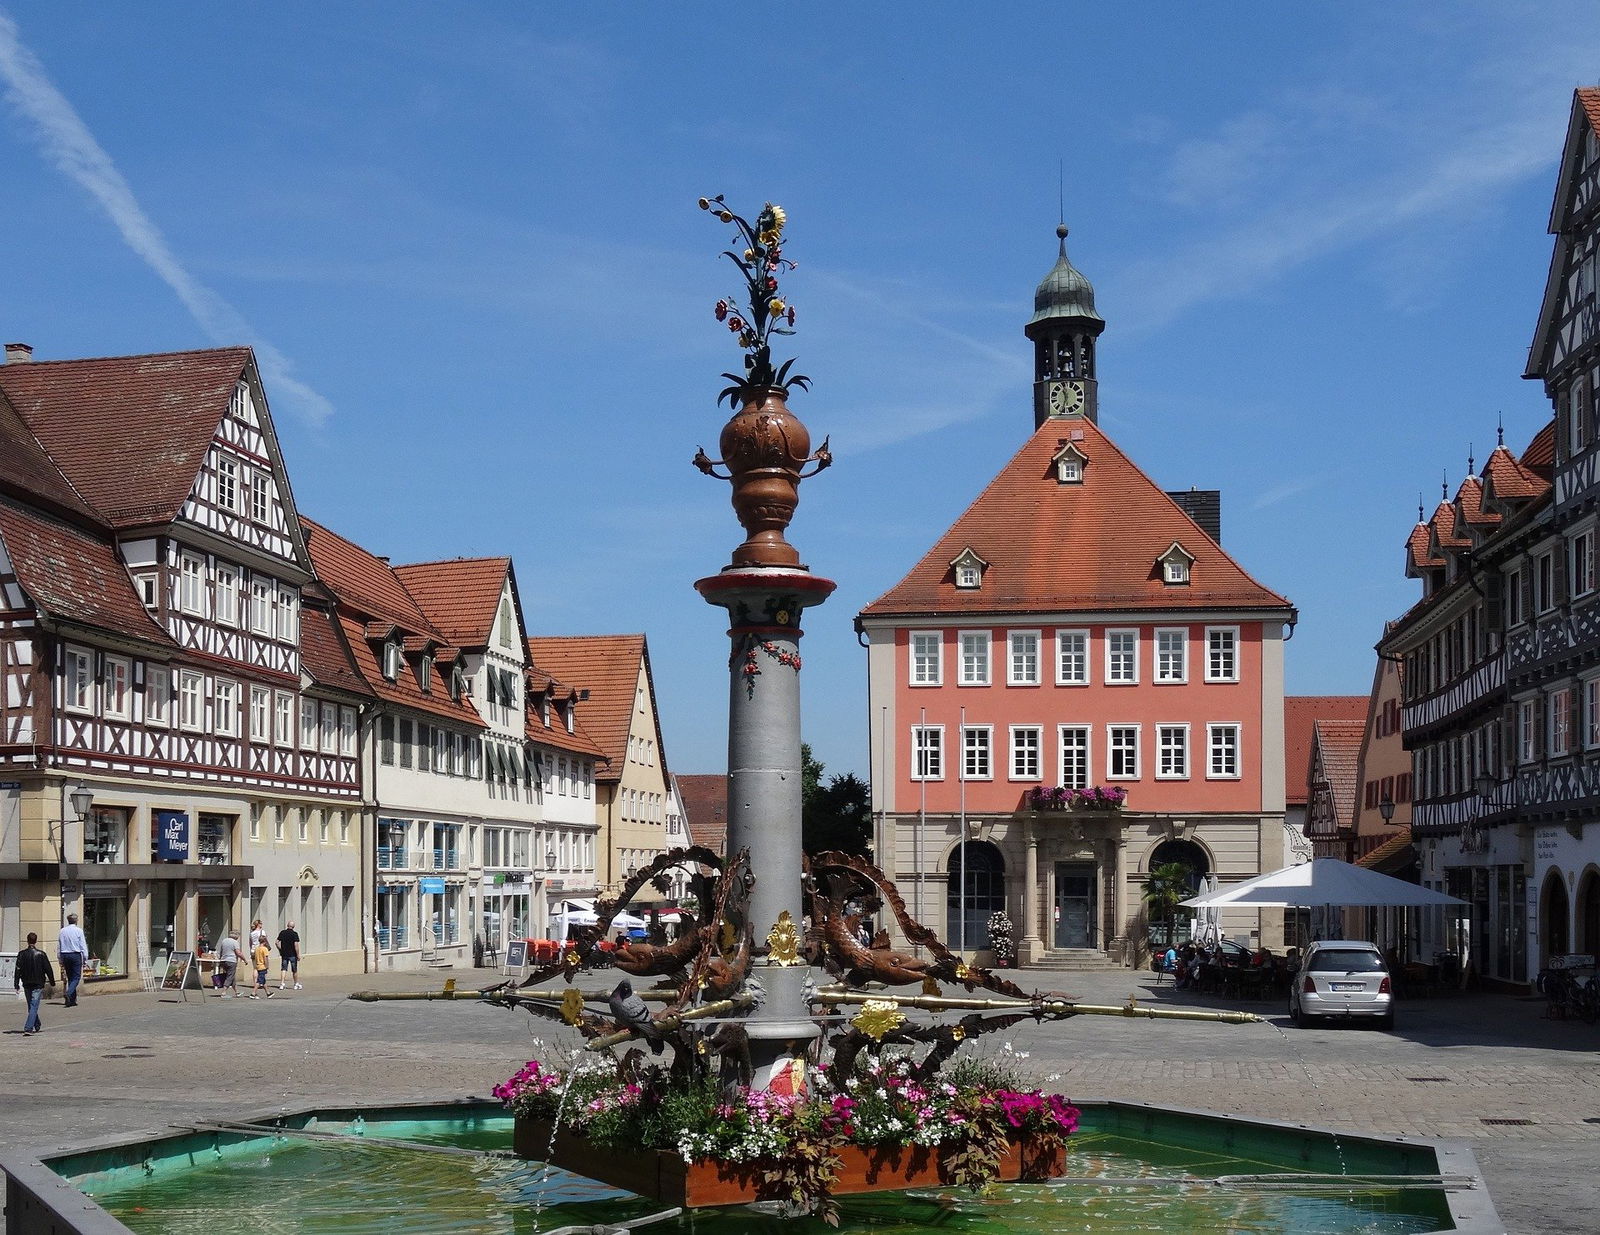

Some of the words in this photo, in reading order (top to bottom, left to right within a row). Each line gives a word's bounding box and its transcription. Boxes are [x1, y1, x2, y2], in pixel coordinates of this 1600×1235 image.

[170, 818, 183, 831] Carl
[165, 829, 179, 839] Max
[170, 840, 188, 851] Meyer
